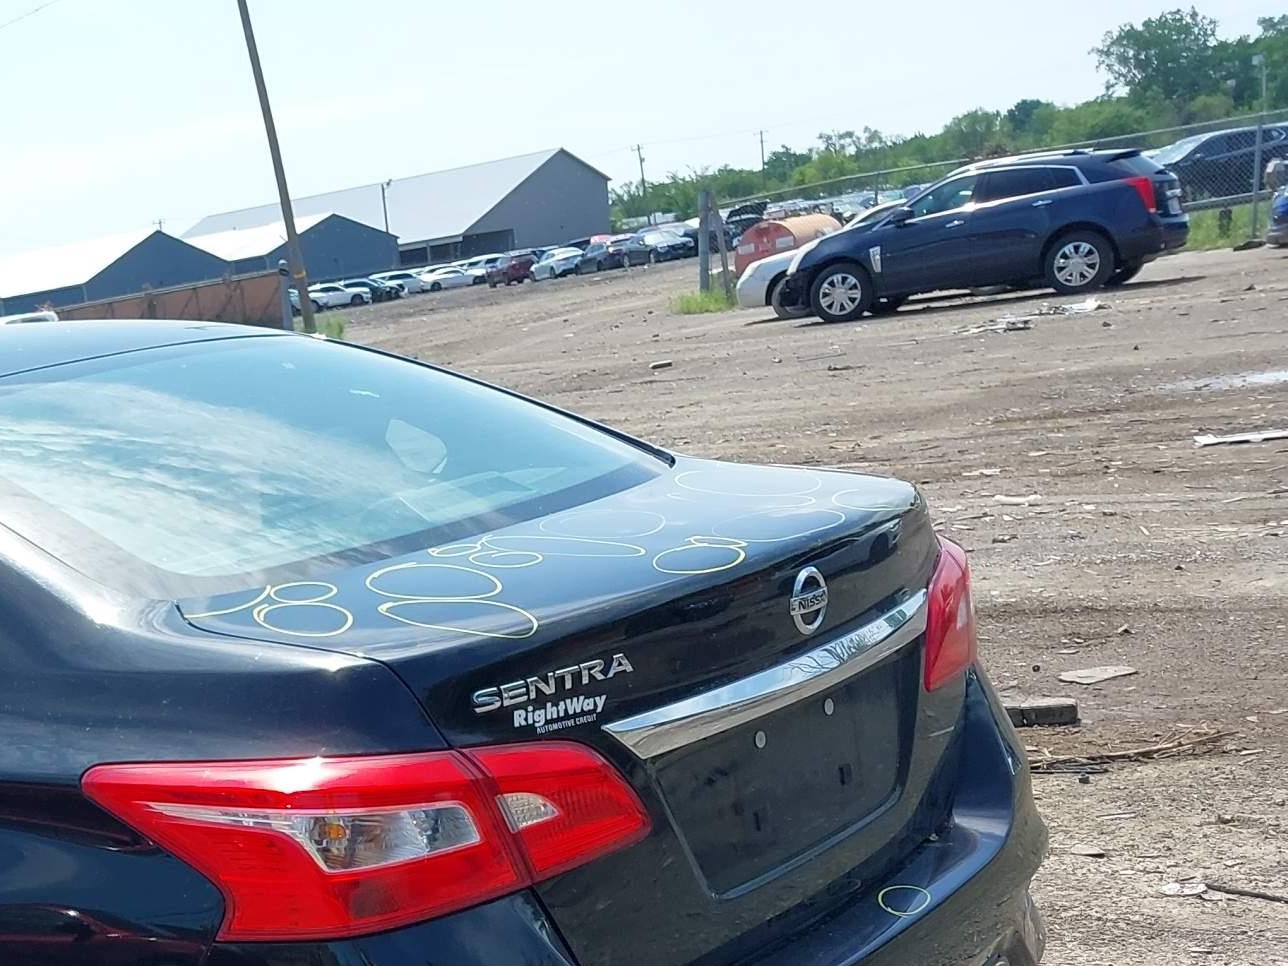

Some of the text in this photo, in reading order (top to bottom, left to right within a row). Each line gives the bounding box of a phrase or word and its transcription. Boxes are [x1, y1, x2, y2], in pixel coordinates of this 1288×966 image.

[472, 653, 634, 713] SENTRA
[513, 694, 607, 728] RightWay
[536, 713, 597, 735] AUTOMOTIVE CREDIT
